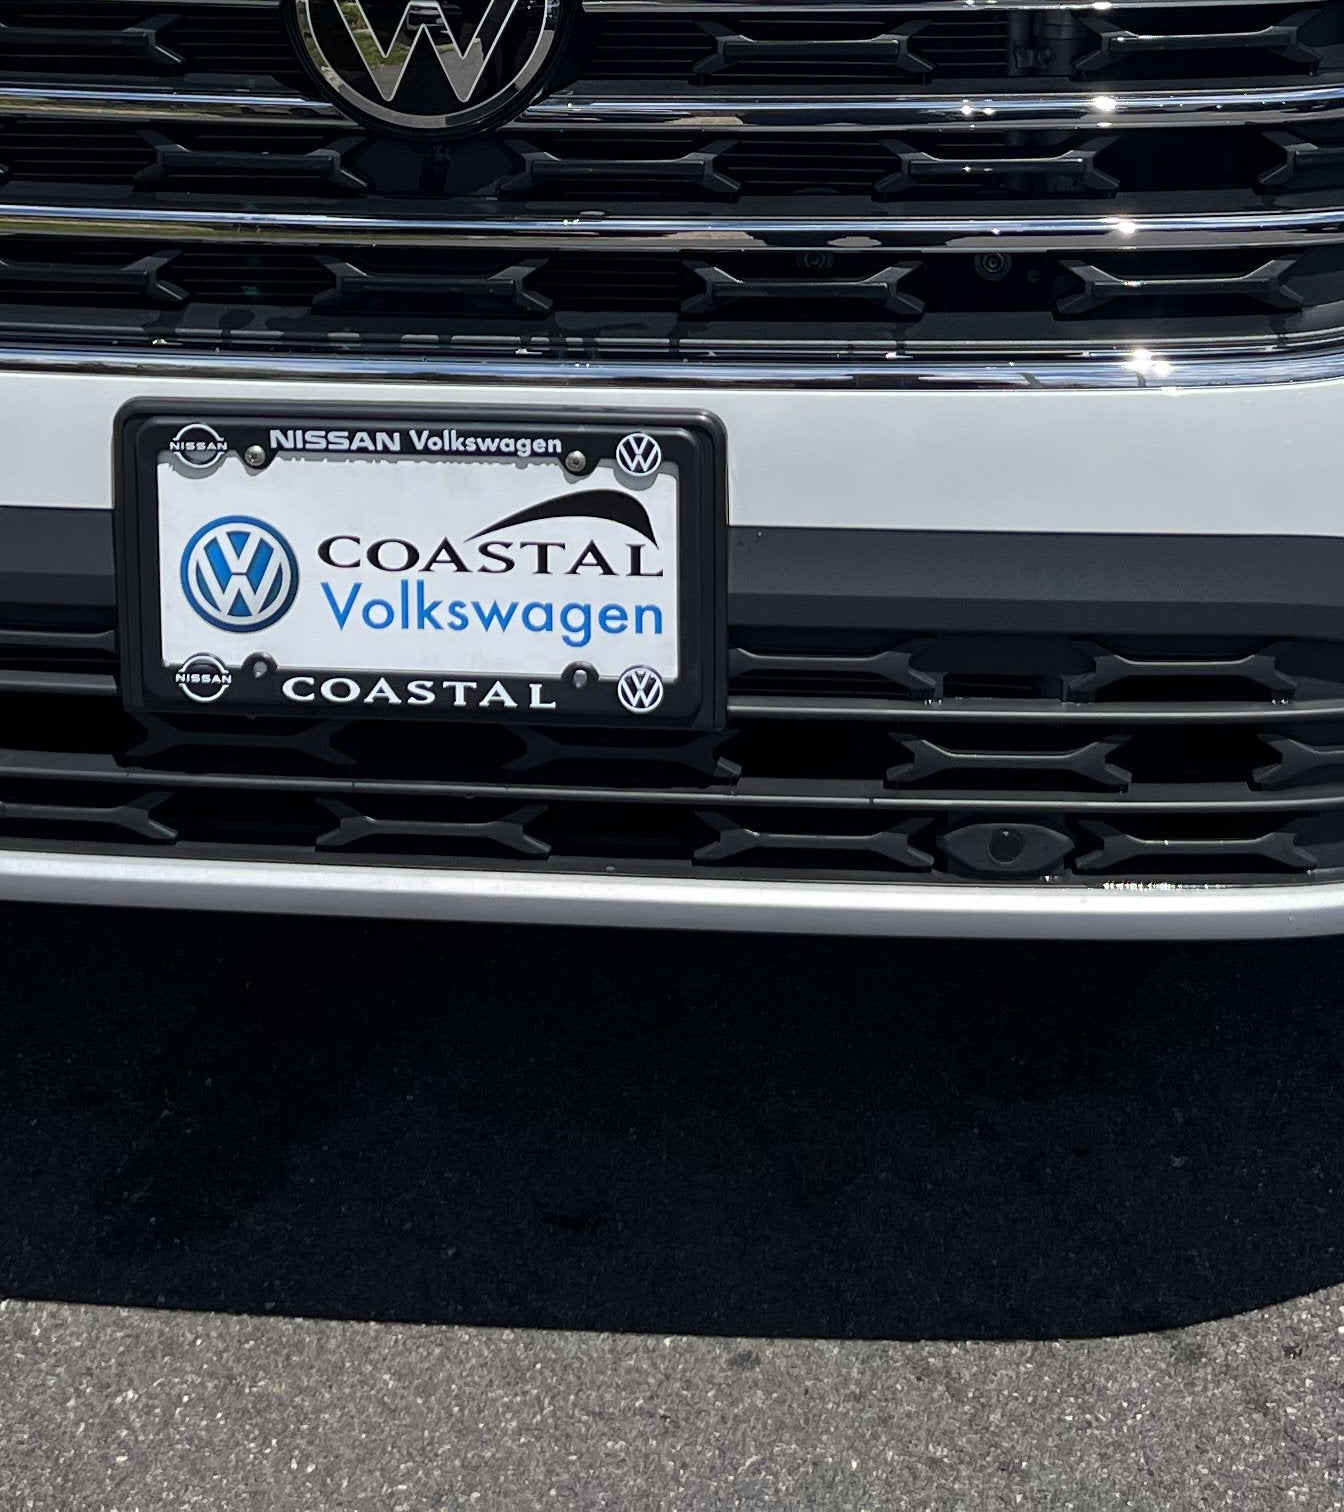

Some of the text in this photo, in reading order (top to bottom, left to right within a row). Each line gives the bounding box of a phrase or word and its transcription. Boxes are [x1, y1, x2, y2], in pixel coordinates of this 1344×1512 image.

[169, 441, 228, 451] NISSAN
[269, 429, 562, 455] NISSAN Volkswagen
[618, 435, 660, 474] VW
[189, 523, 291, 624] VW
[317, 535, 664, 577] COASTAL
[321, 579, 663, 648] Volkswagen
[175, 673, 232, 684] NISSAN
[282, 676, 557, 709] COASTAL
[619, 668, 662, 710] VW
